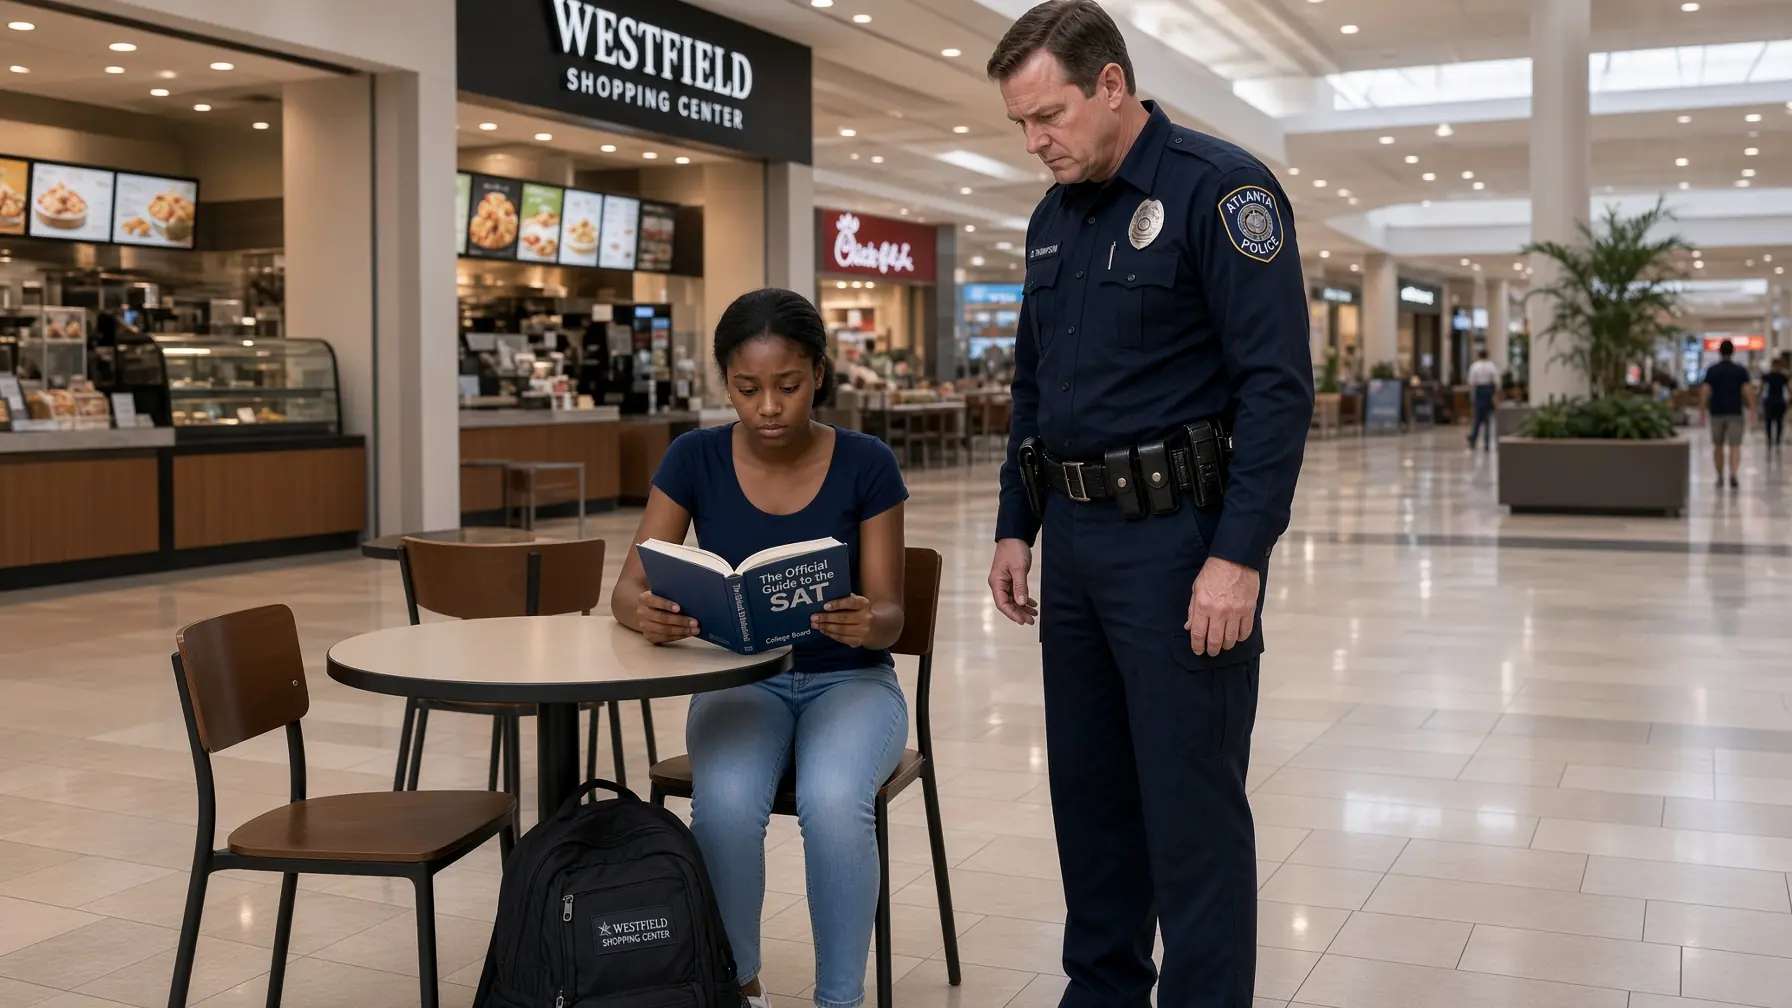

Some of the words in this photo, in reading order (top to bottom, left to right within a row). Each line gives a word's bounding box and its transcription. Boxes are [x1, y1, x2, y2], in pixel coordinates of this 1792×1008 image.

[553, 0, 753, 100] WESTFIELD
[566, 67, 671, 113] SHOPPING
[677, 95, 744, 130] CENTER
[1226, 190, 1273, 214] ATLANTA
[1240, 235, 1280, 254] POLICE
[759, 573, 782, 585] The
[785, 559, 828, 578] Official
[762, 579, 797, 594] Guide
[799, 577, 812, 585] to
[814, 571, 834, 582] the
[770, 582, 829, 612] SAT
[765, 634, 790, 644] College
[791, 629, 811, 639] Board
[612, 917, 668, 934] WESTFIELD
[602, 934, 641, 947] SHOPPING
[642, 930, 671, 941] CENTER
